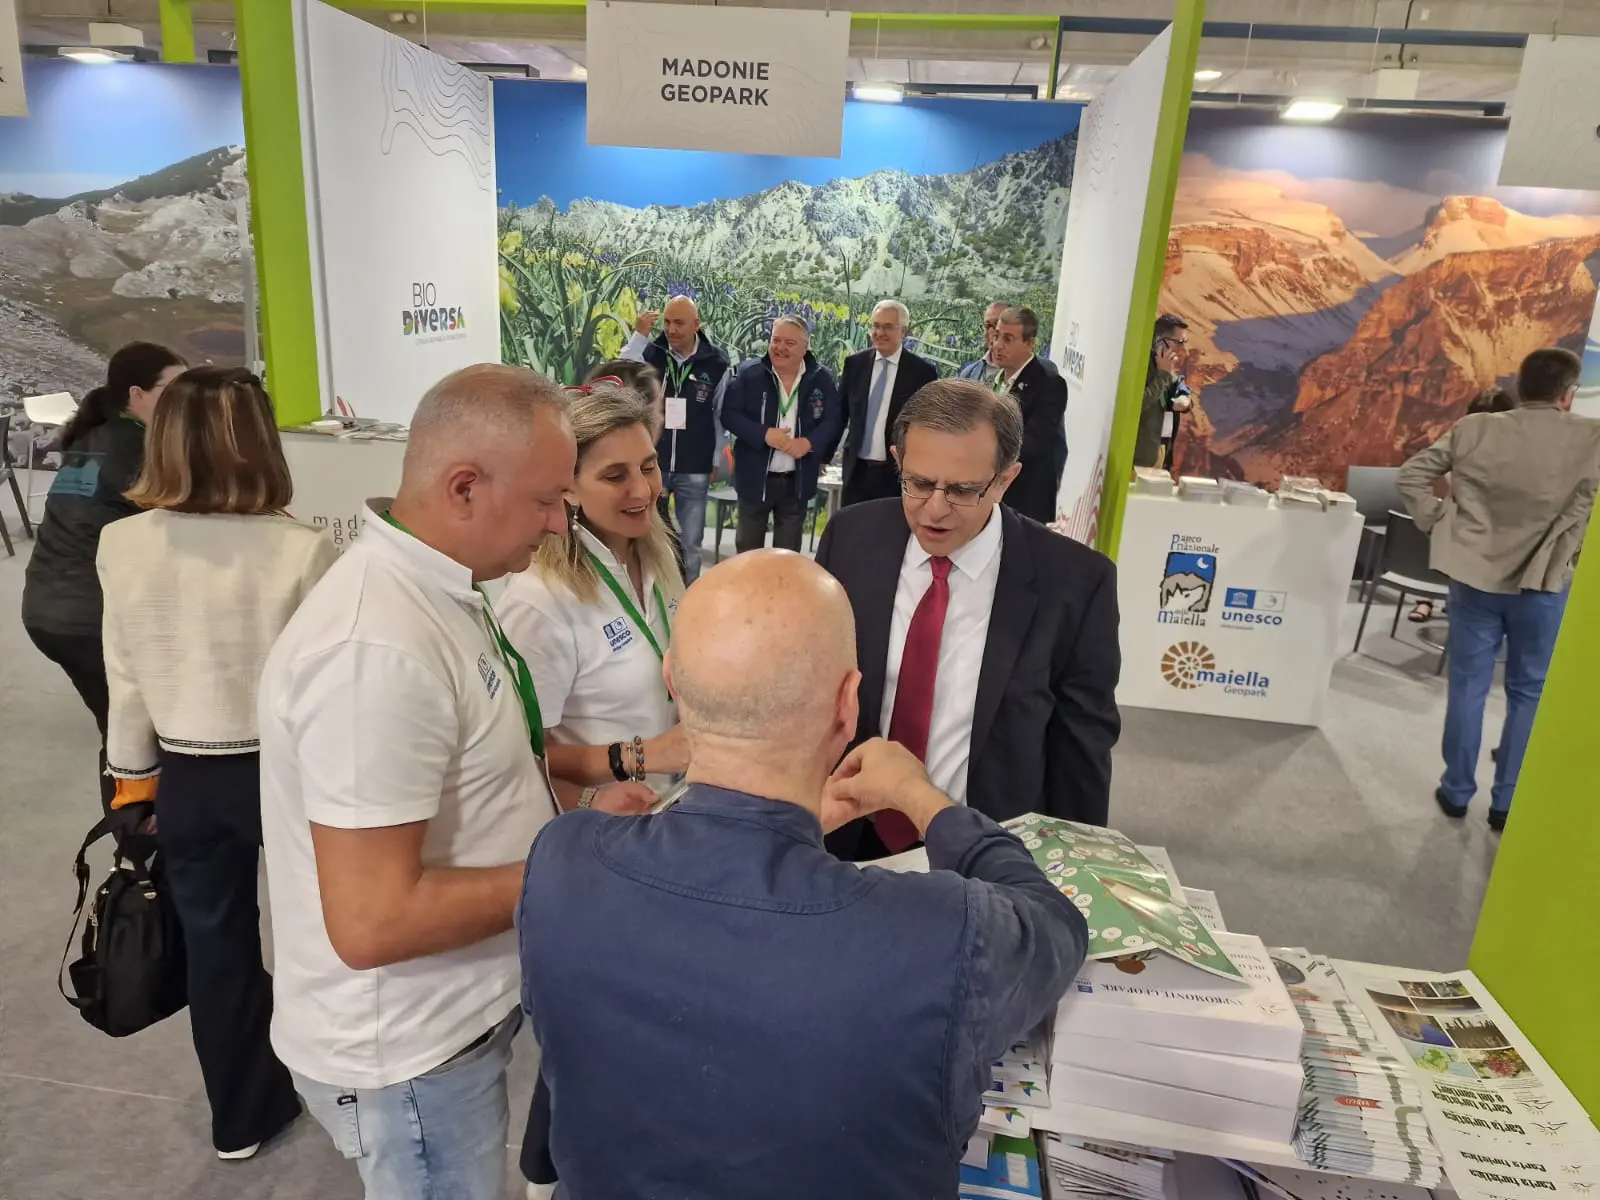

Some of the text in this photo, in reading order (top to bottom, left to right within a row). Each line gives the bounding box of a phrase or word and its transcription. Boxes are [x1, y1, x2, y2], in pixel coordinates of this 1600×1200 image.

[662, 57, 770, 81] MADONIE
[661, 83, 769, 106] GEOPARK
[412, 282, 437, 308] BIO
[1221, 611, 1283, 626] unesco
[1196, 669, 1270, 688] maiella
[1223, 685, 1268, 698] Geopark
[1432, 1090, 1513, 1115] Carta turistica
[1441, 1111, 1492, 1130] turistica
[1490, 1121, 1526, 1135] Carta
[1460, 1151, 1547, 1173] Carta turistica
[1468, 1169, 1557, 1191] Carta turistica
